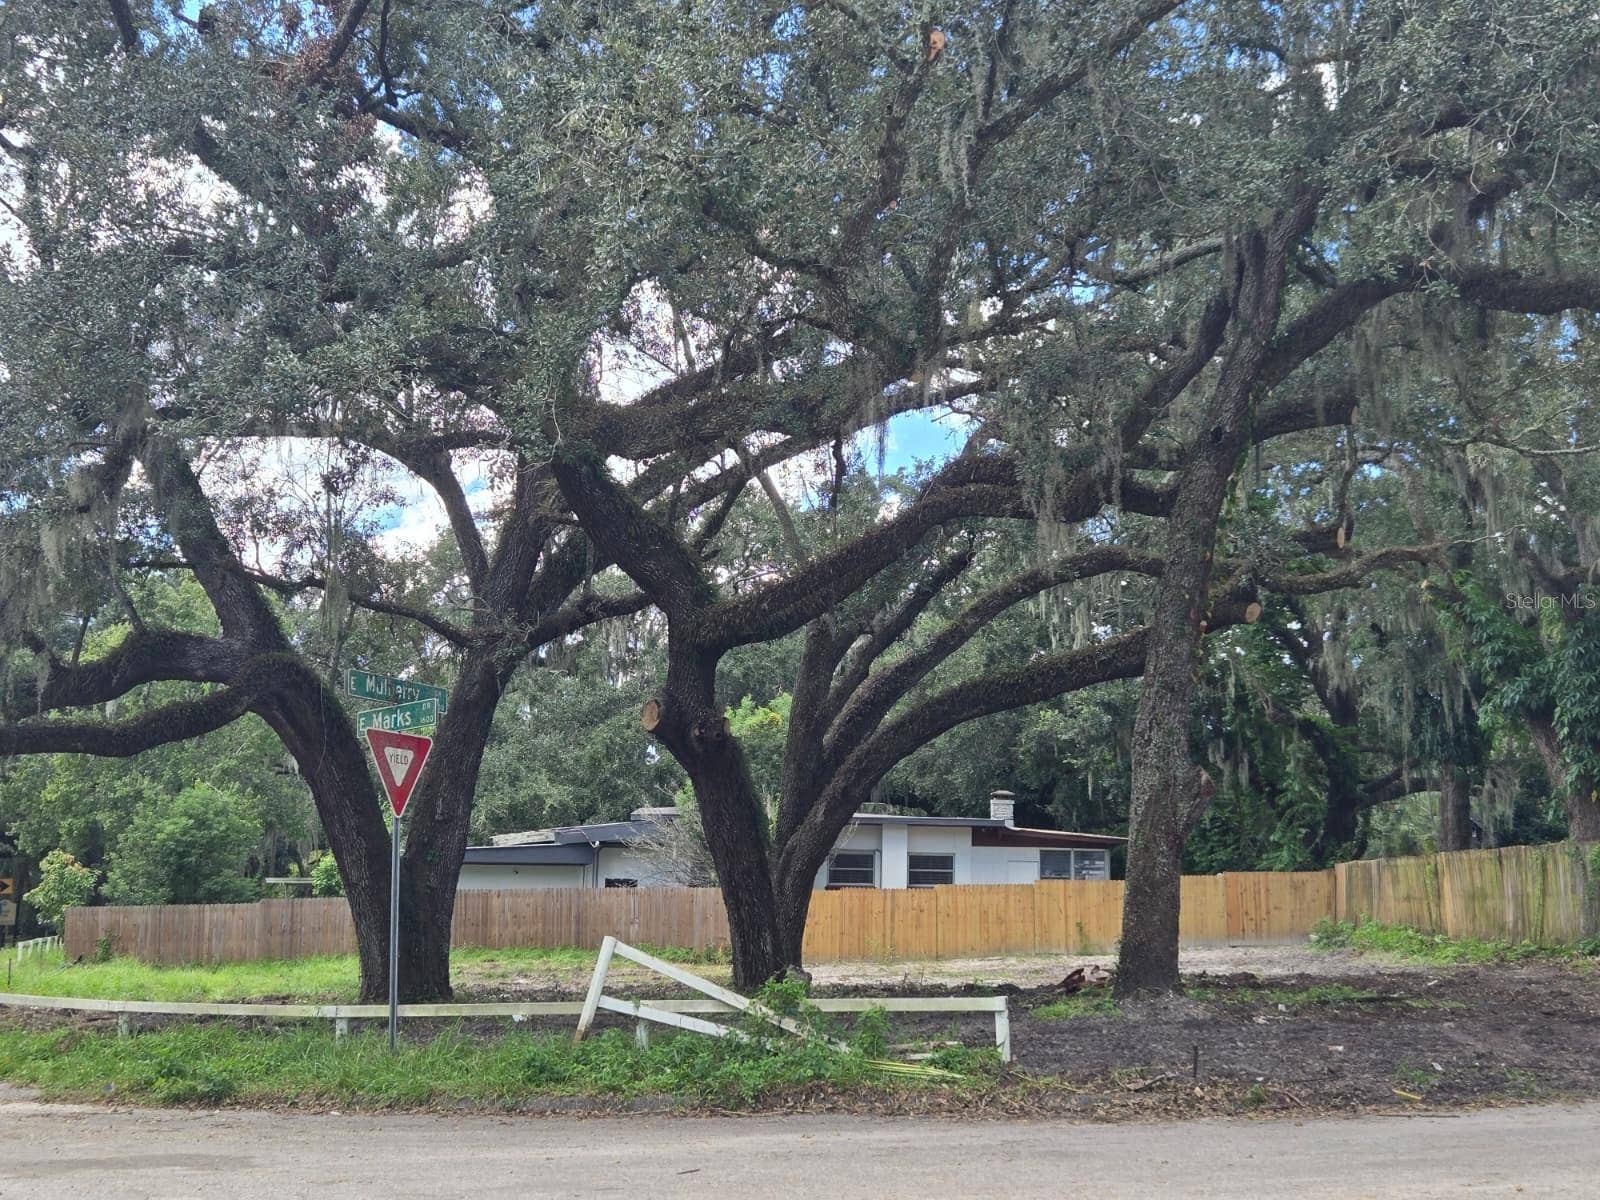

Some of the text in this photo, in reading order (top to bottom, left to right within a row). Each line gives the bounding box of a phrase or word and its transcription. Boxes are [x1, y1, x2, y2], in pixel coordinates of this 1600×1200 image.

[351, 676, 357, 690] E
[360, 709, 412, 731] E Marks
[390, 752, 409, 766] YIELD
